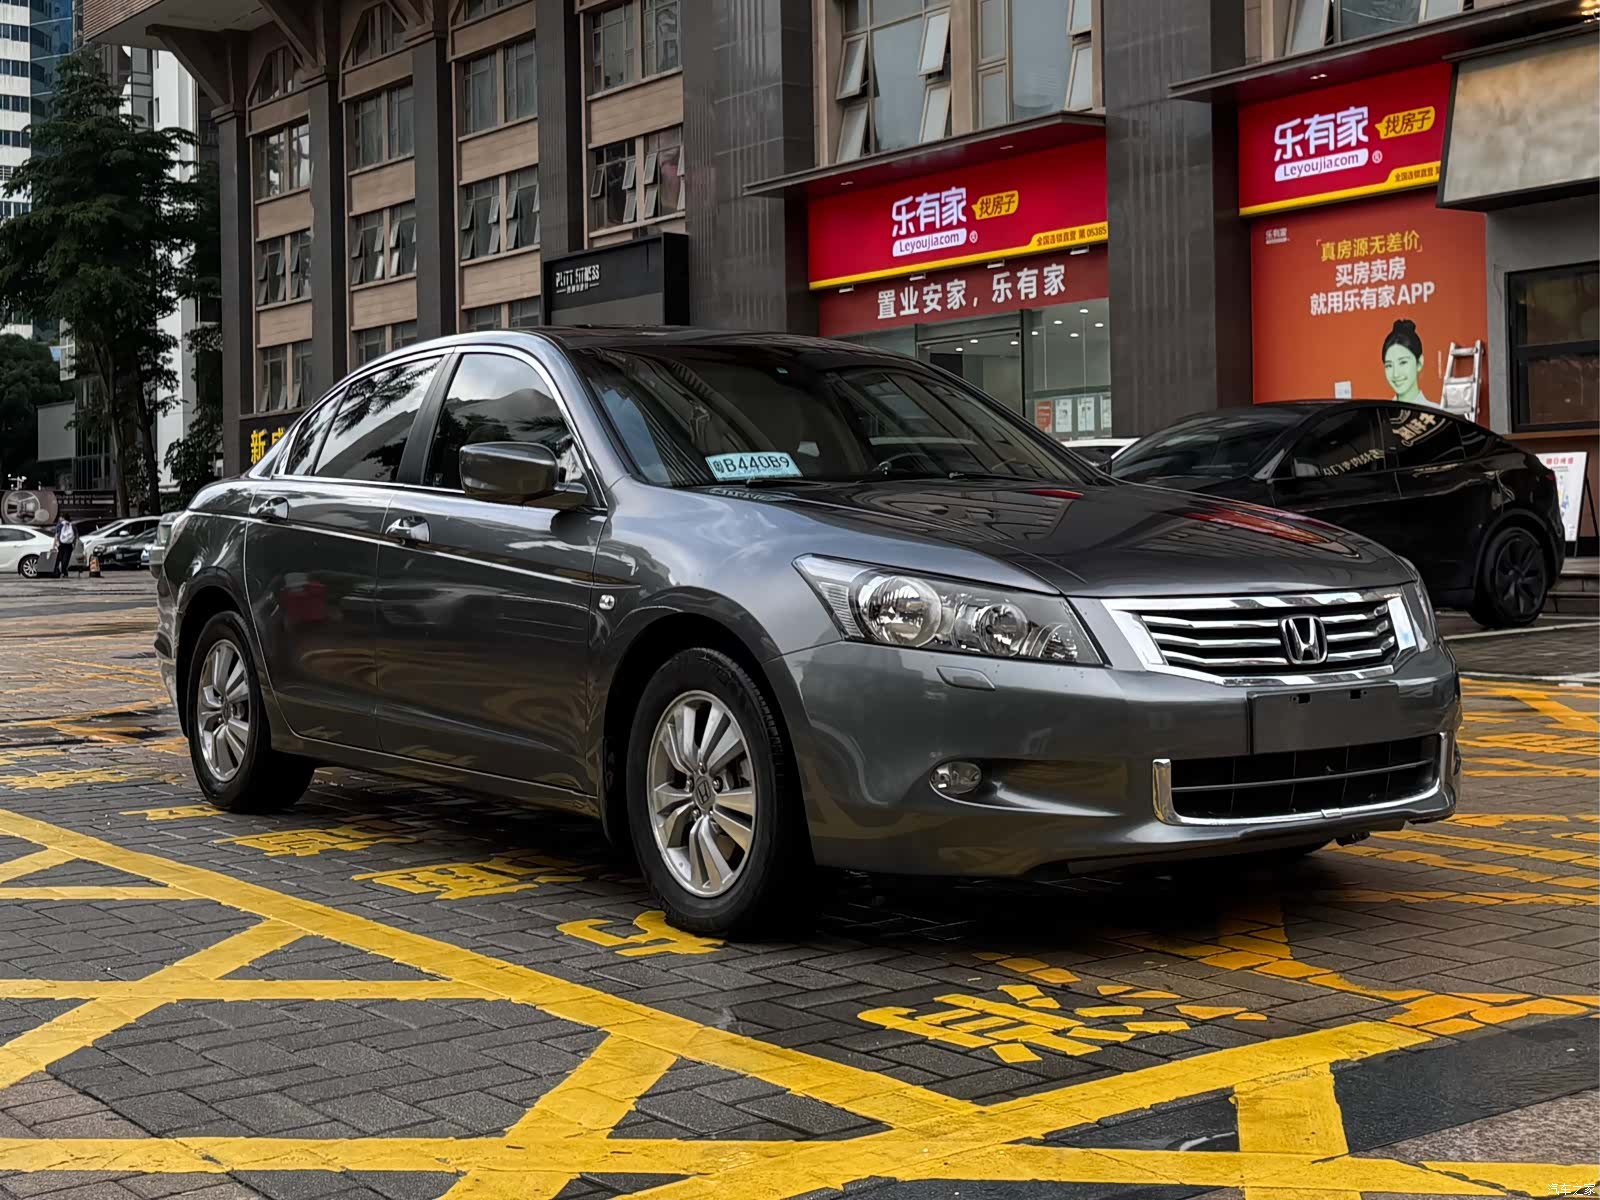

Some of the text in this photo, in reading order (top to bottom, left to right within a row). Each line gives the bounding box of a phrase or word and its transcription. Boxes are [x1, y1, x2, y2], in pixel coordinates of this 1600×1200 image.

[1274, 106, 1369, 162] 乐有家
[1384, 109, 1431, 137] 找房子
[892, 186, 967, 237] 乐有家
[979, 193, 1016, 218] 找房子
[575, 264, 600, 284] FITNESS
[1335, 256, 1407, 288] 买房卖房
